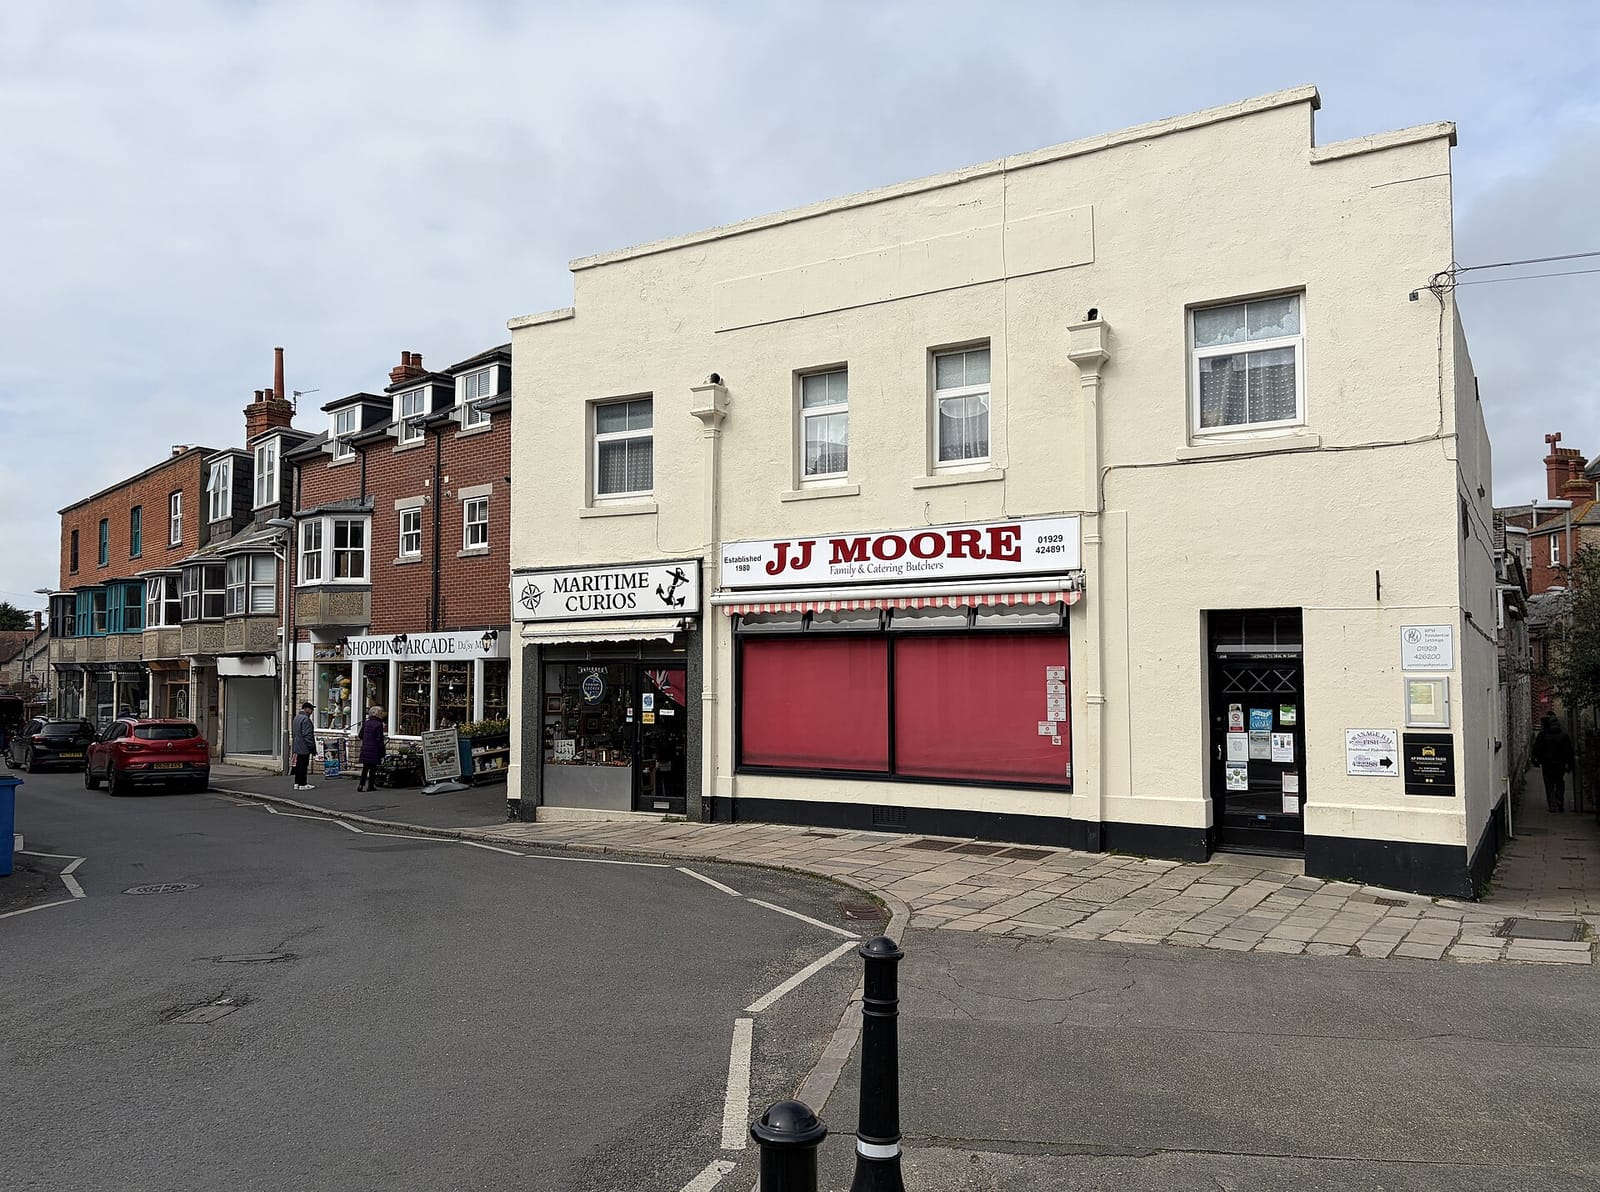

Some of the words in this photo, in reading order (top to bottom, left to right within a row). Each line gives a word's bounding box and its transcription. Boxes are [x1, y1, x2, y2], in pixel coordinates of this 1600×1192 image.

[1037, 534, 1063, 544] 01929
[766, 542, 815, 576] JJ
[829, 526, 1022, 564] MOORE
[1035, 545, 1065, 554] 424891
[724, 554, 762, 564] Established
[735, 564, 750, 572] 1980
[830, 563, 856, 577] Family
[858, 564, 865, 574] &
[867, 562, 903, 575] Catering
[906, 559, 944, 572] Butchers
[553, 572, 649, 593] MARITIME
[565, 592, 636, 611] CURIOS
[405, 637, 455, 654] ARCADE
